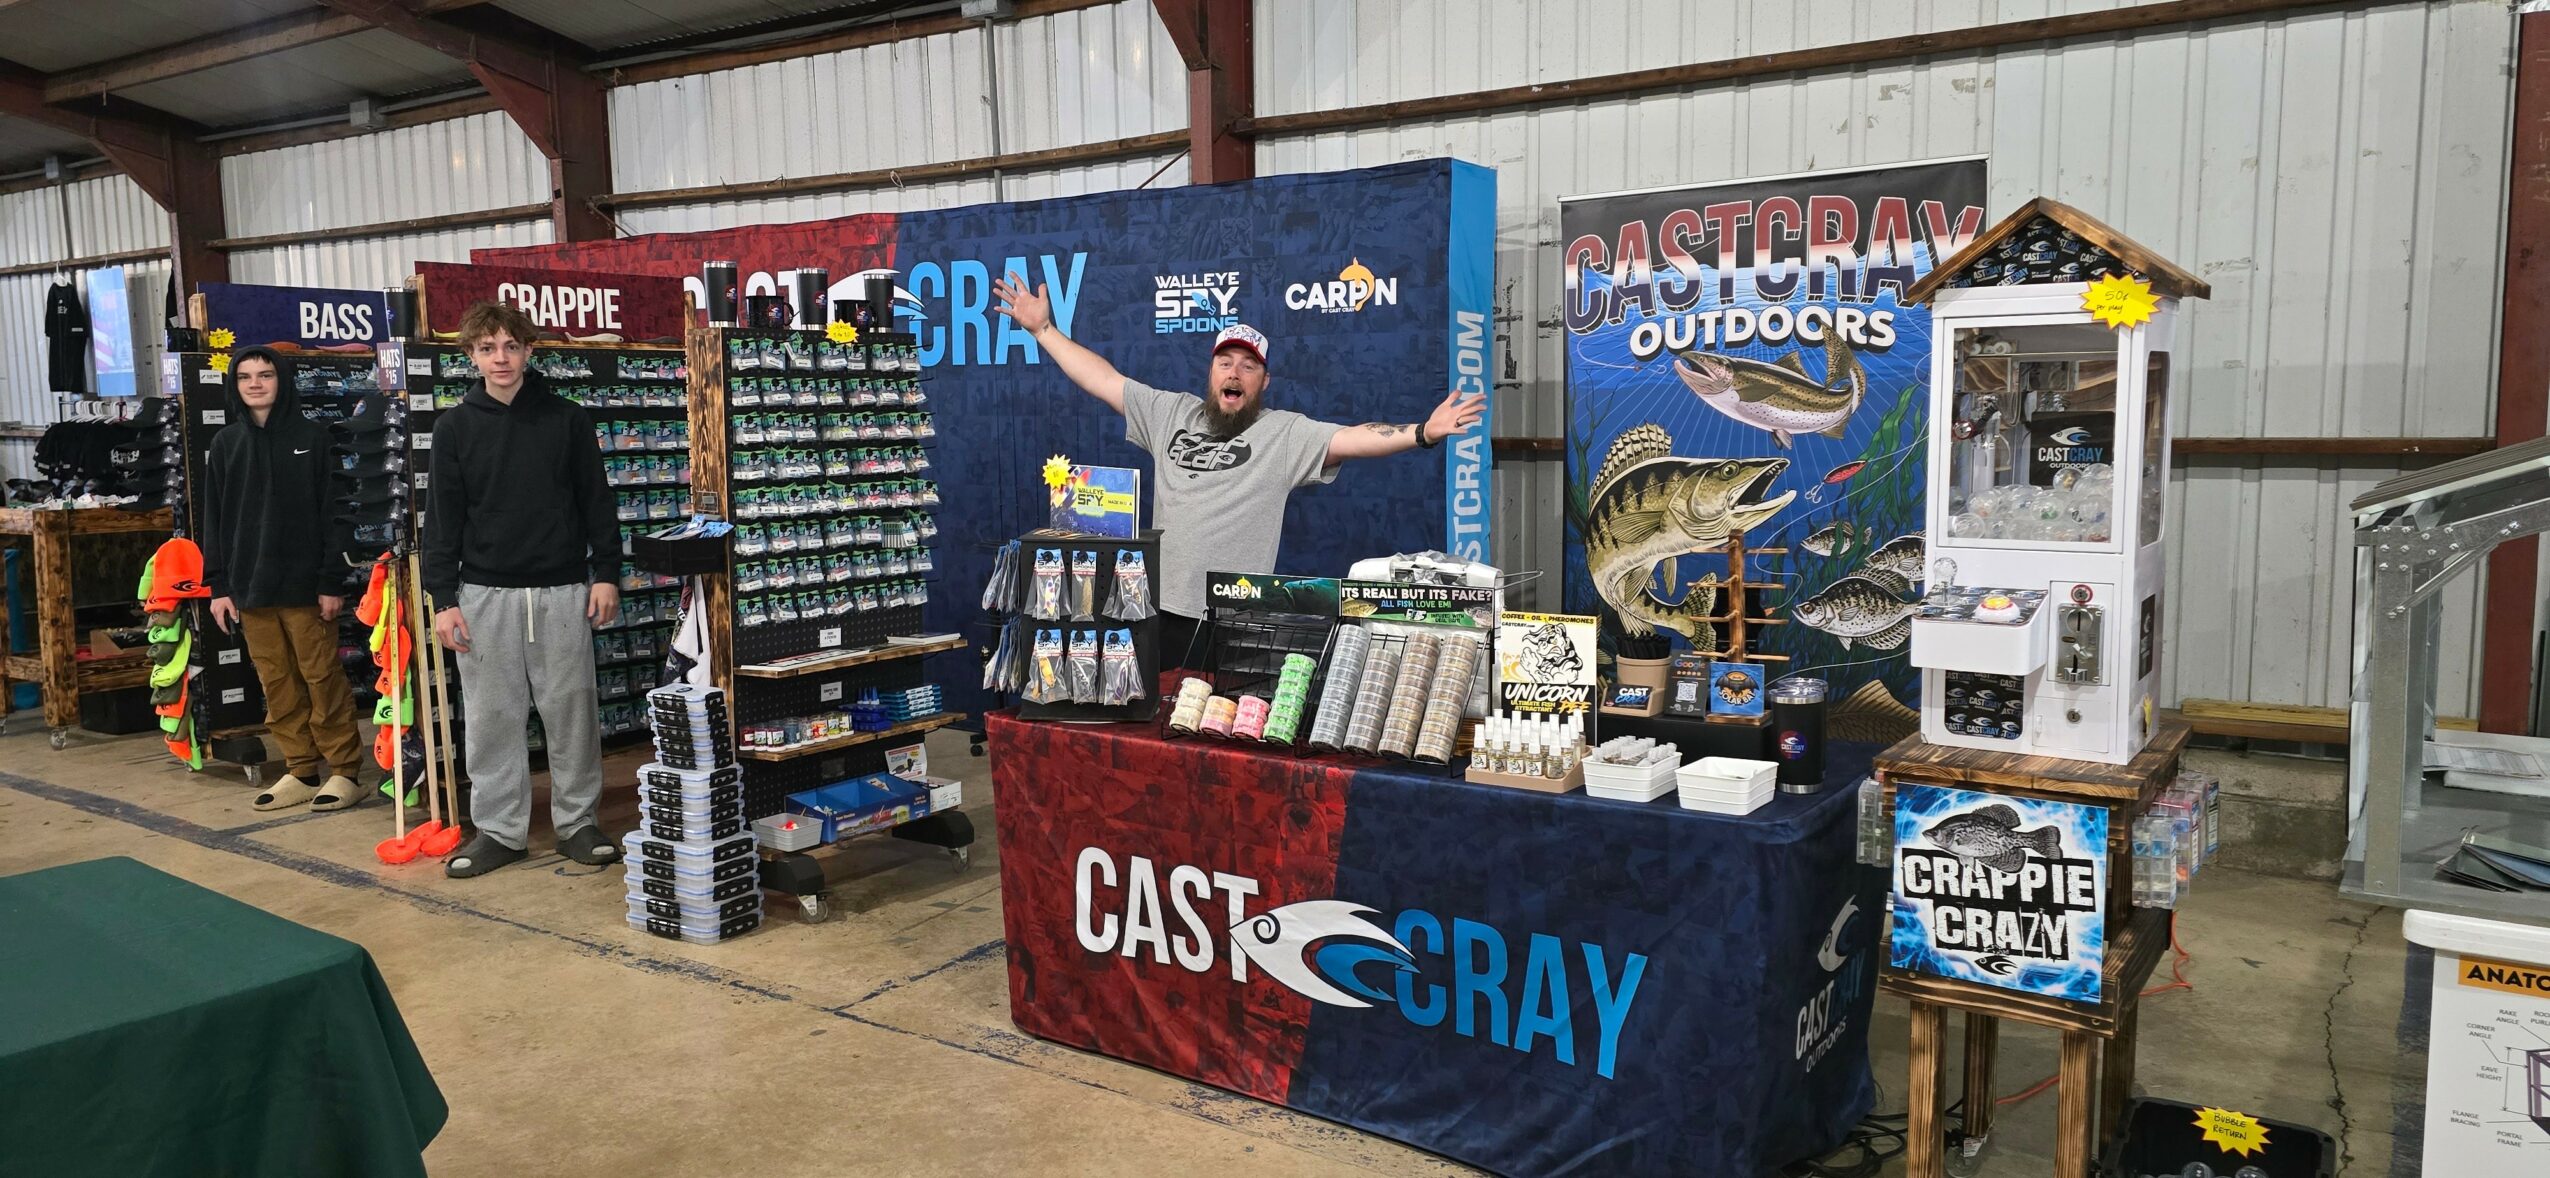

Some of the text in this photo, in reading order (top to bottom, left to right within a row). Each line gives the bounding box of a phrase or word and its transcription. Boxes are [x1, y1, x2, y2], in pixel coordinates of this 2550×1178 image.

[2022, 251, 2059, 263] CASTCRAY
[1565, 195, 1984, 335] CASTCRAY
[1155, 271, 1240, 288] WALLEYE
[1155, 287, 1239, 318] SPY
[2105, 290, 2129, 301] 50¢
[909, 252, 1089, 367] CRAY
[299, 301, 374, 341] BASS
[1155, 316, 1238, 334] SPOONS
[1630, 306, 1896, 359] OUTDOORS
[380, 349, 400, 369] HATS
[163, 358, 178, 375] HATS
[385, 369, 397, 385] $15
[2037, 447, 2103, 462] CASTCRAY
[1077, 487, 1105, 495] WALLEYE
[1341, 587, 1493, 601] ITS REAL! BUT ITS FAKE?
[1381, 600, 1395, 608] ALL
[1396, 600, 1414, 608] FISH
[1415, 600, 1436, 608] LOVE
[1548, 616, 1594, 625] PHEROMONES
[1674, 658, 1706, 669] Google
[1505, 683, 1590, 702] UNICORN
[1619, 687, 1649, 697] CAST
[1718, 689, 1742, 705] SOLAR
[1559, 700, 1592, 715] PEE
[1966, 725, 2000, 735] CASTCRAY
[1904, 855, 2094, 907] CRAPPIE
[1935, 905, 2066, 956] CRAZY
[1074, 846, 1650, 1081] CAST CRAY
[2499, 1009, 2517, 1018] RAKE
[2466, 1022, 2496, 1033] CORNER
[2496, 1016, 2519, 1026] ANGLE
[2469, 1030, 2492, 1040] ANGLE
[2480, 1065, 2499, 1074] EAVE
[2476, 1072, 2502, 1082] HEIGHT
[2213, 1112, 2247, 1128] BUBBLE
[2452, 1109, 2479, 1120] FLANGE
[2450, 1117, 2481, 1128] BRACING
[2213, 1125, 2247, 1140] RETURN
[2496, 1130, 2523, 1141] PORTAL
[2497, 1138, 2522, 1149] FRAME
